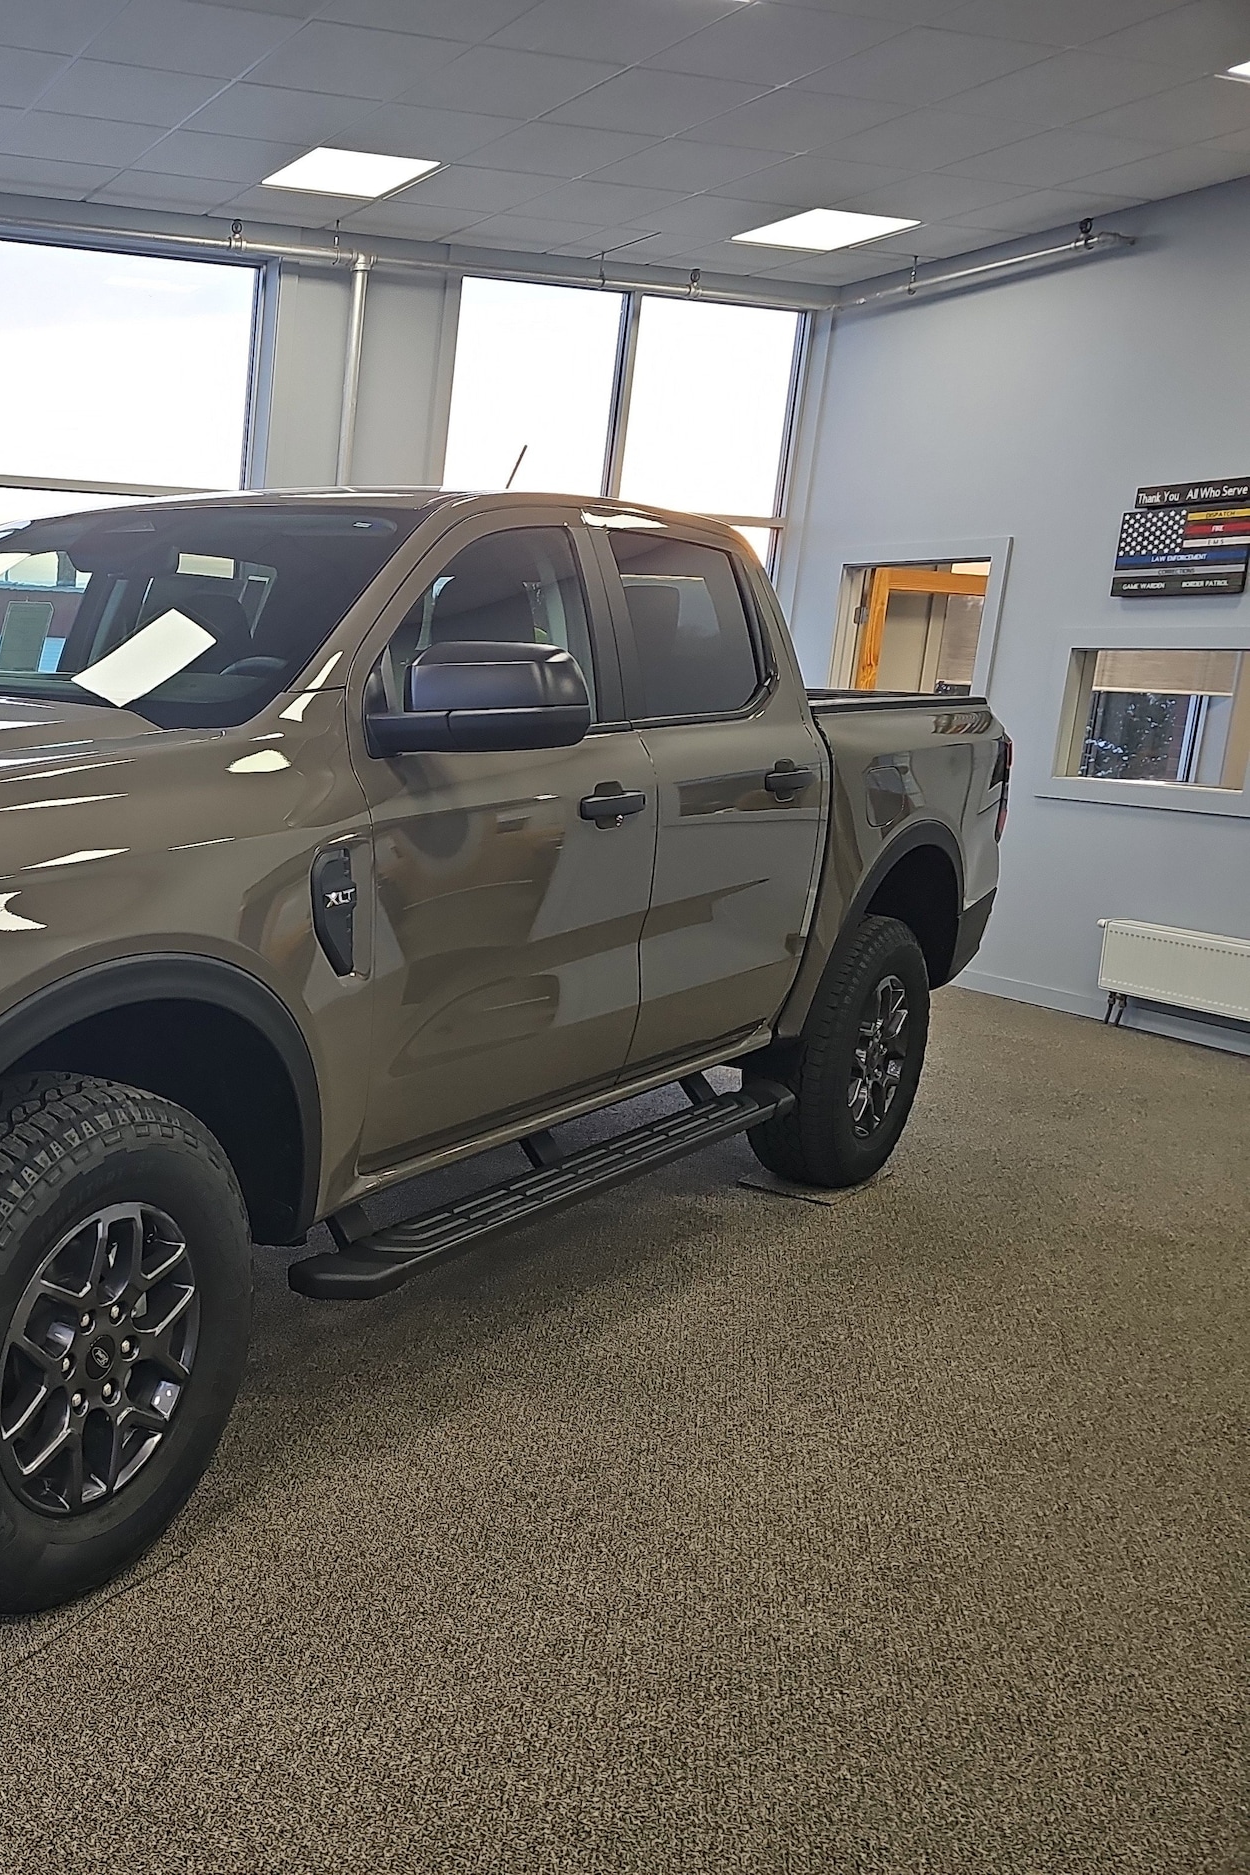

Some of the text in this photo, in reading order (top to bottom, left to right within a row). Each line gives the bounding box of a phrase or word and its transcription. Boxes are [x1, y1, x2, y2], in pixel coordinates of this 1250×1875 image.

[1138, 484, 1248, 505] Thank You All Who Serve
[1205, 511, 1236, 519] DISPATCH
[1151, 553, 1208, 563] LAW ENFORCEMENT
[1122, 582, 1166, 590] GAME WARDEN
[1181, 579, 1229, 588] BORDER PATROL
[325, 888, 356, 909] XLT
